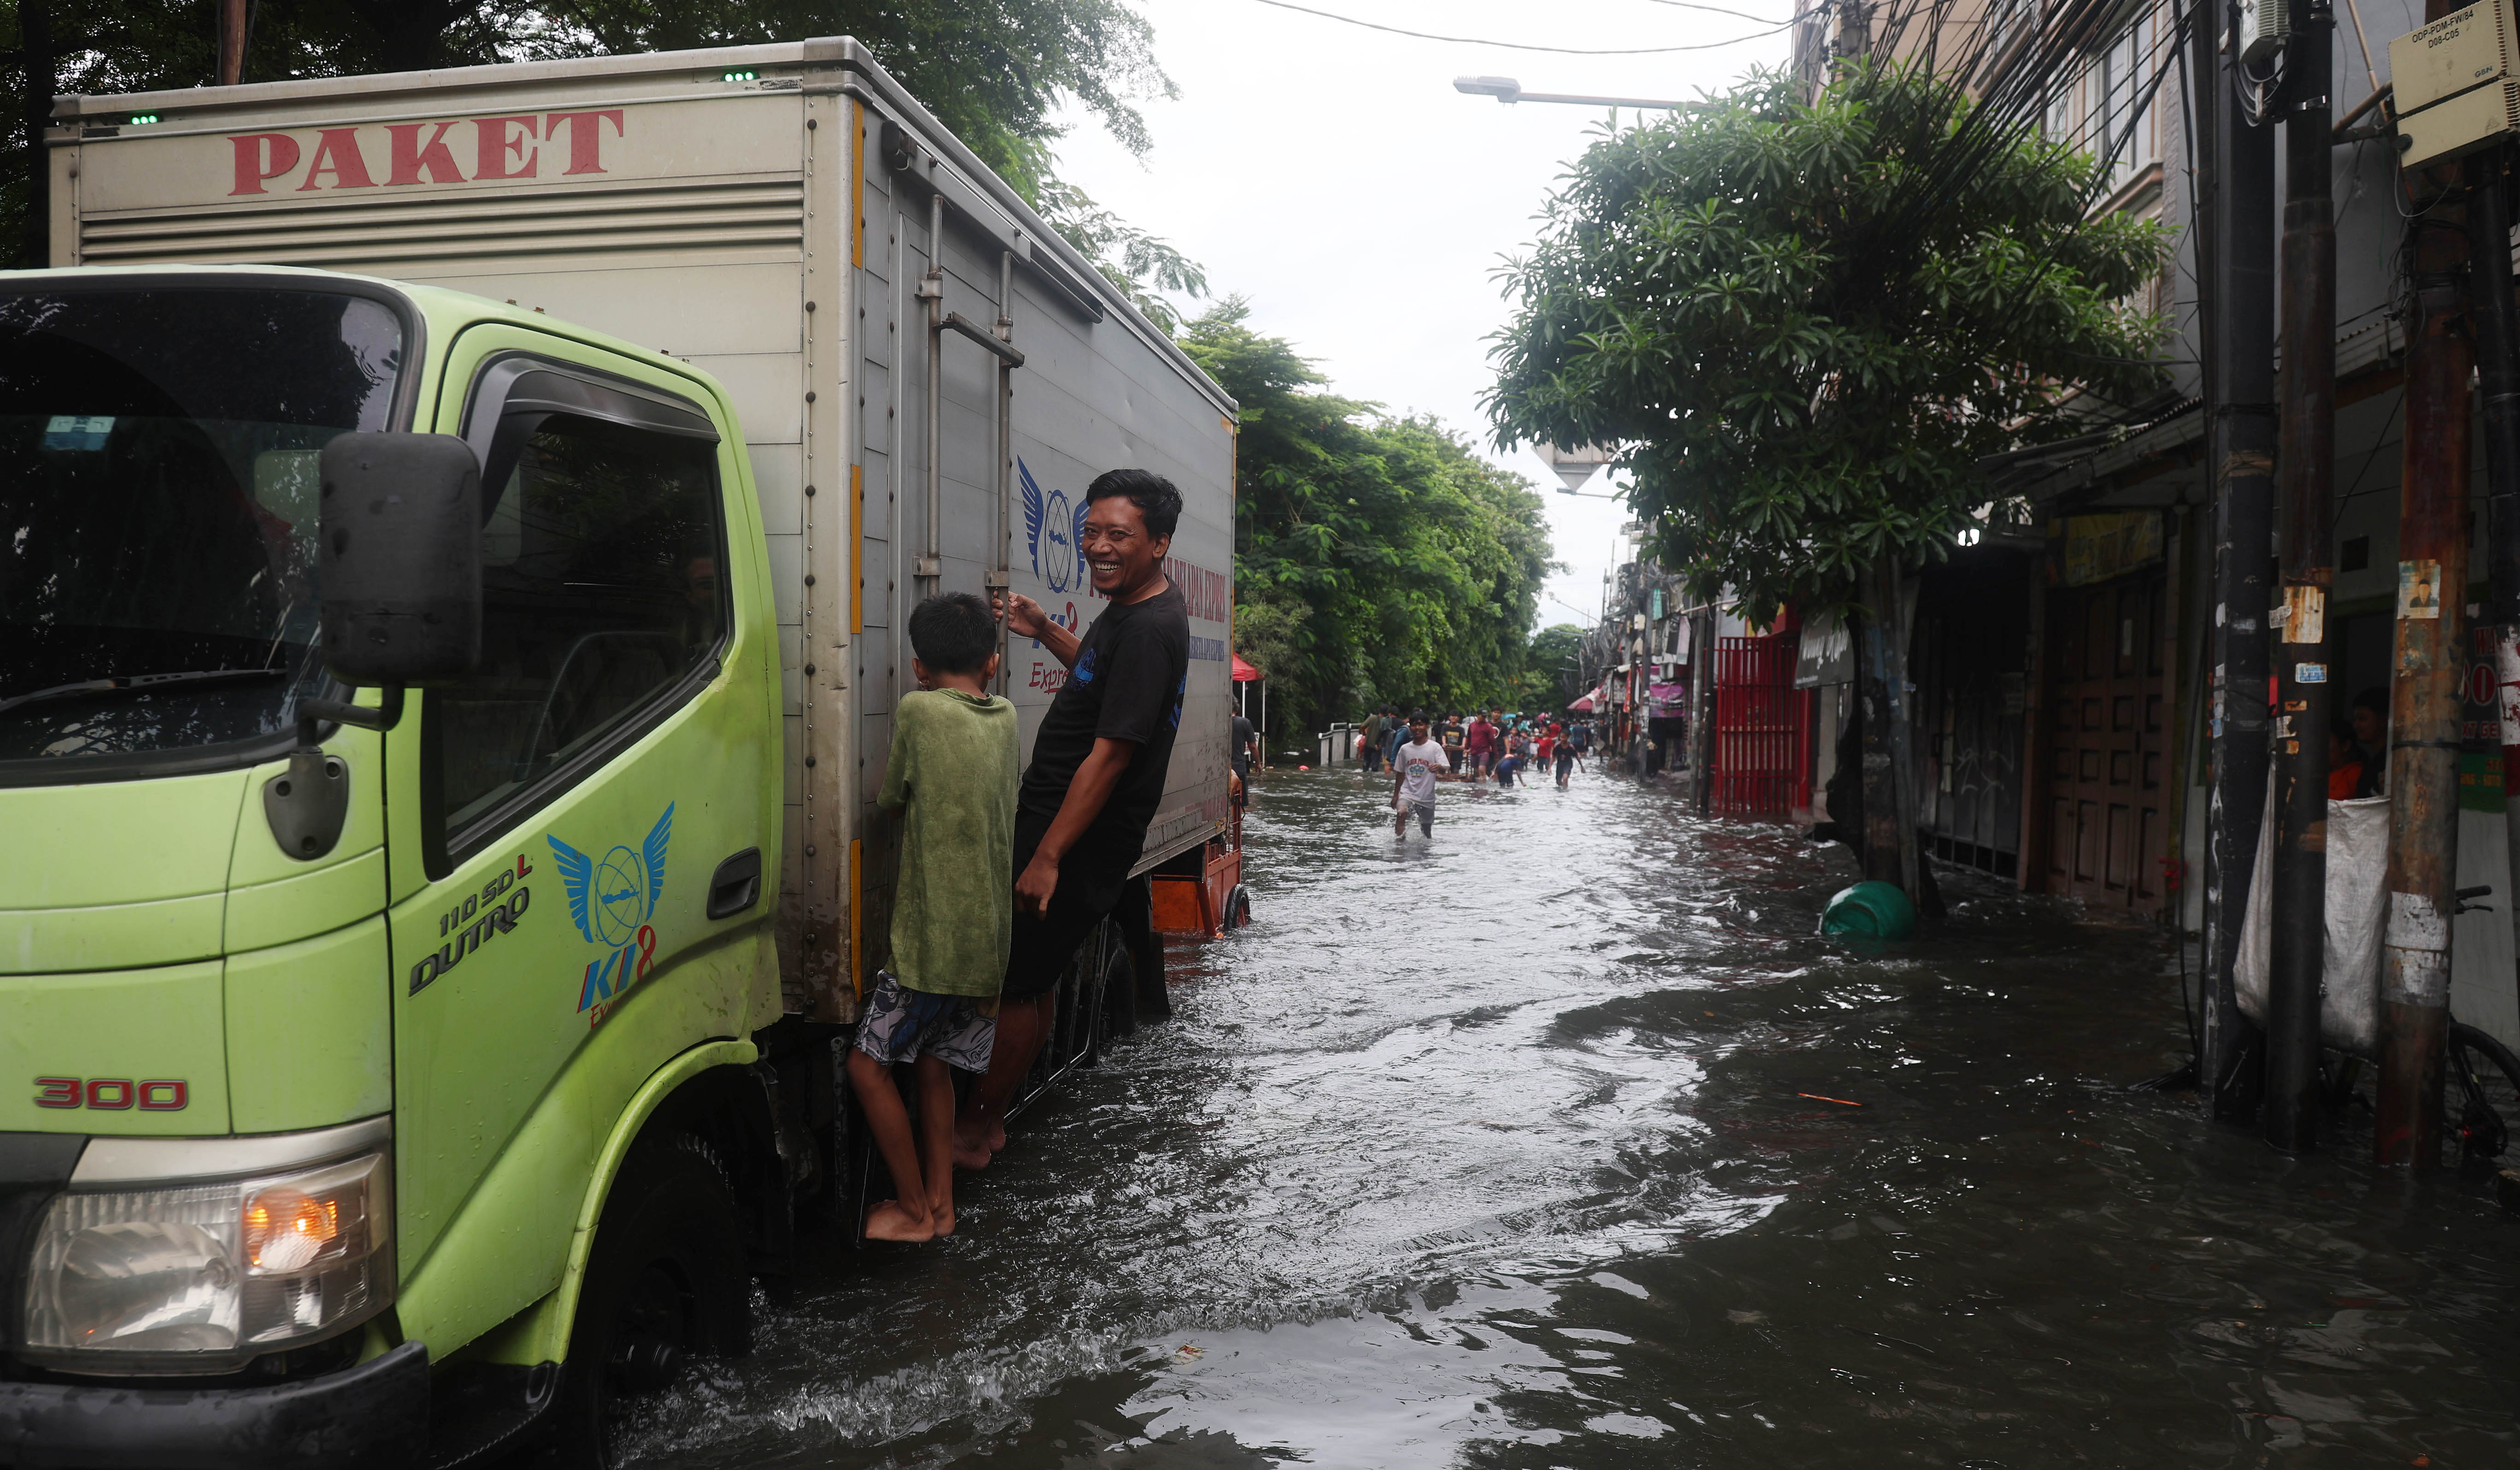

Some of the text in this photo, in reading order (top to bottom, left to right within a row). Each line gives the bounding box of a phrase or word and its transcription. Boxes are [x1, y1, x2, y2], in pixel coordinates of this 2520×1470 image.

[2412, 9, 2474, 43] ODP-PDM-FW/84
[2428, 28, 2460, 48] D08-C05
[227, 109, 624, 196] PAKET
[1204, 570, 1225, 623] EXPRES
[408, 886, 529, 998] DUTRO
[576, 924, 656, 1014] KI8
[33, 1076, 188, 1111] 300
